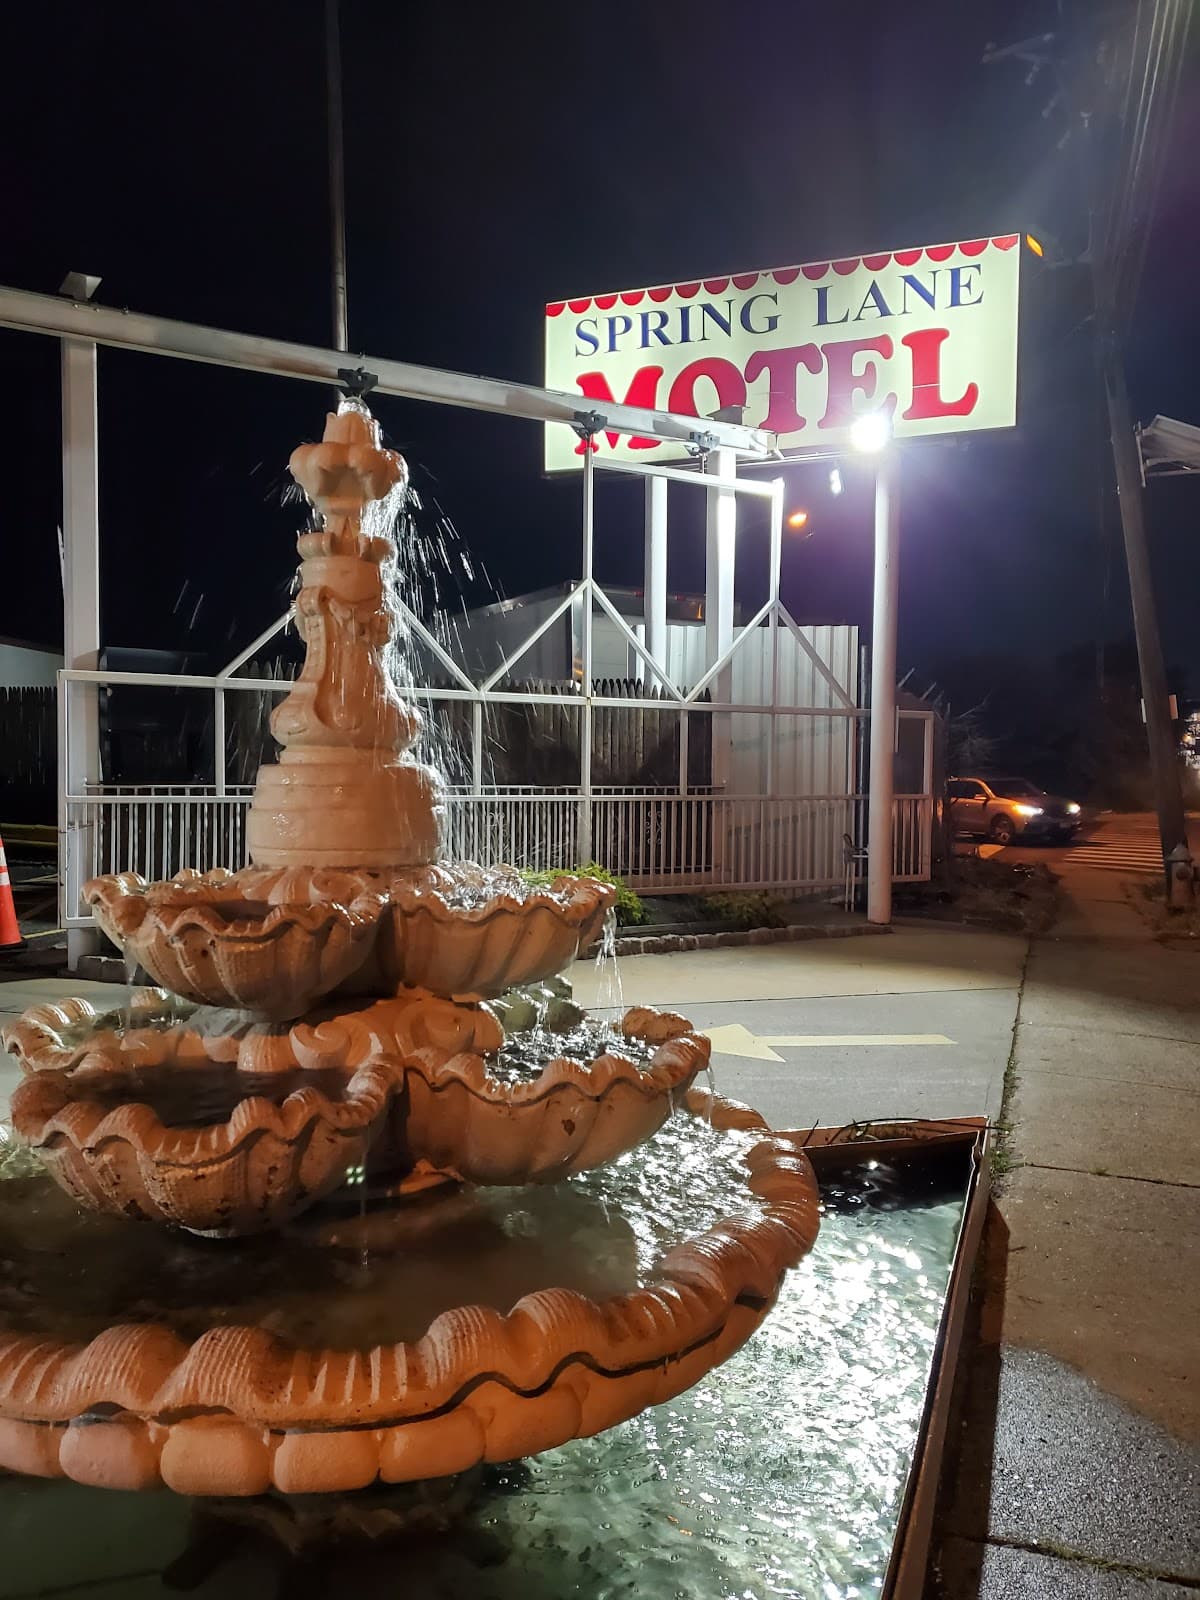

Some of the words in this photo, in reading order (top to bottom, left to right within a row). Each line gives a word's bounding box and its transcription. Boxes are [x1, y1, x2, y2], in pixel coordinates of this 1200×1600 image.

[576, 292, 782, 357] SPRING
[813, 264, 984, 327] LANE
[575, 328, 979, 455] MOTEL
